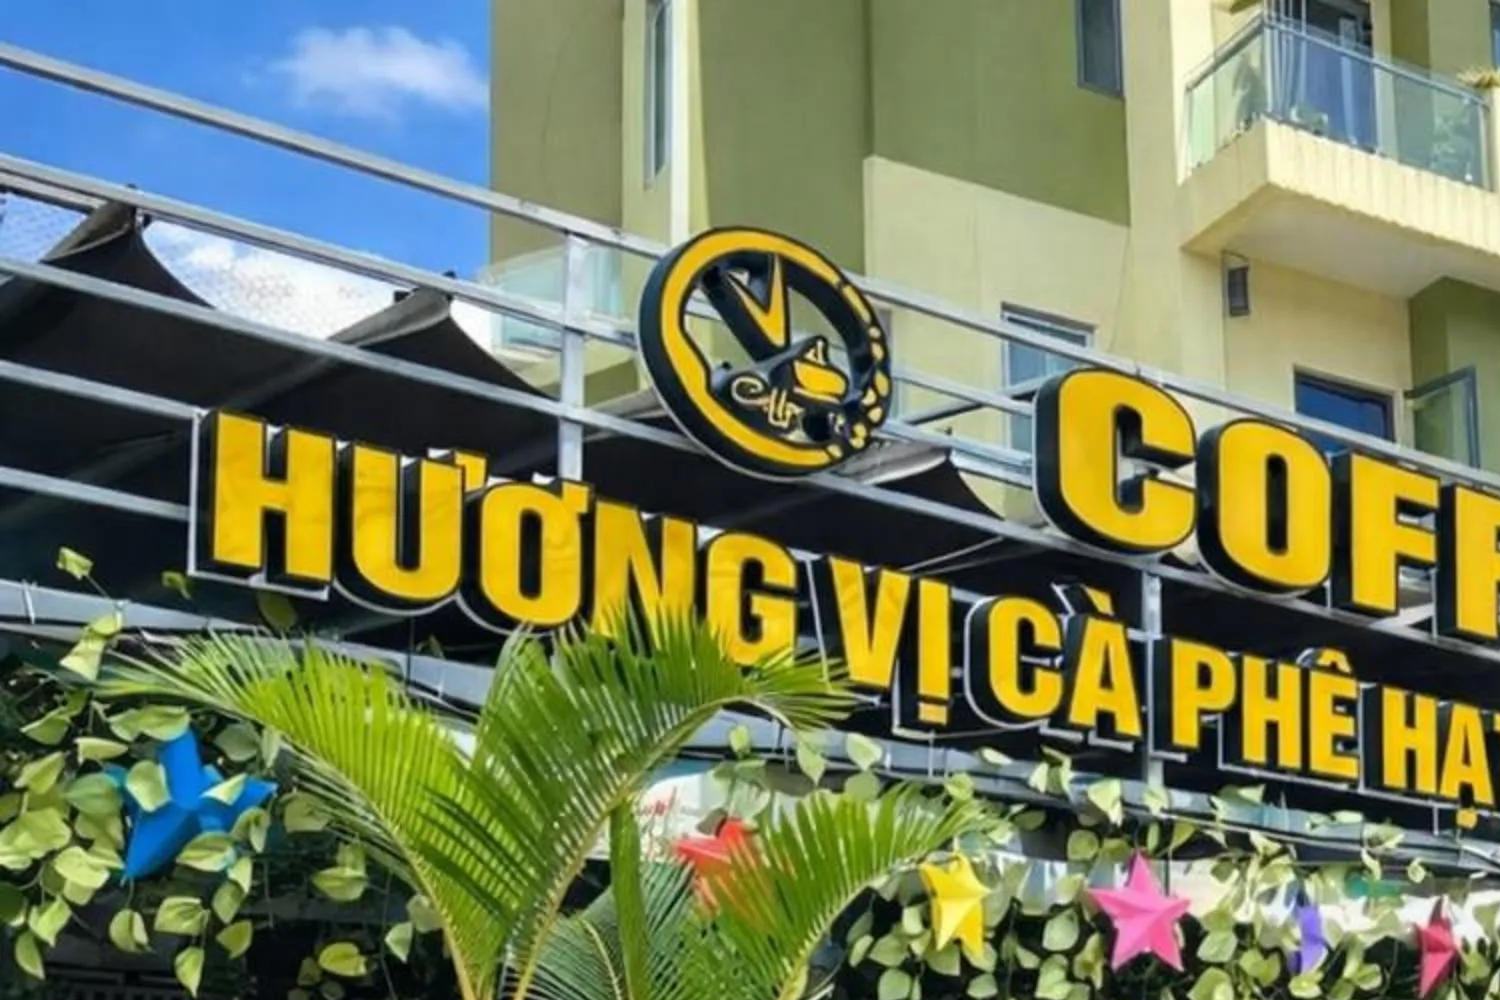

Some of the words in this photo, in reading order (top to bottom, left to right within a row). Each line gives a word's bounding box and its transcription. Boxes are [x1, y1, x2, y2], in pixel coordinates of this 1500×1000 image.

[210, 411, 797, 668] HƯƠNG
[829, 555, 950, 727] VỊ
[987, 584, 1143, 738] CÀ
[1170, 637, 1360, 780] PHÊ
